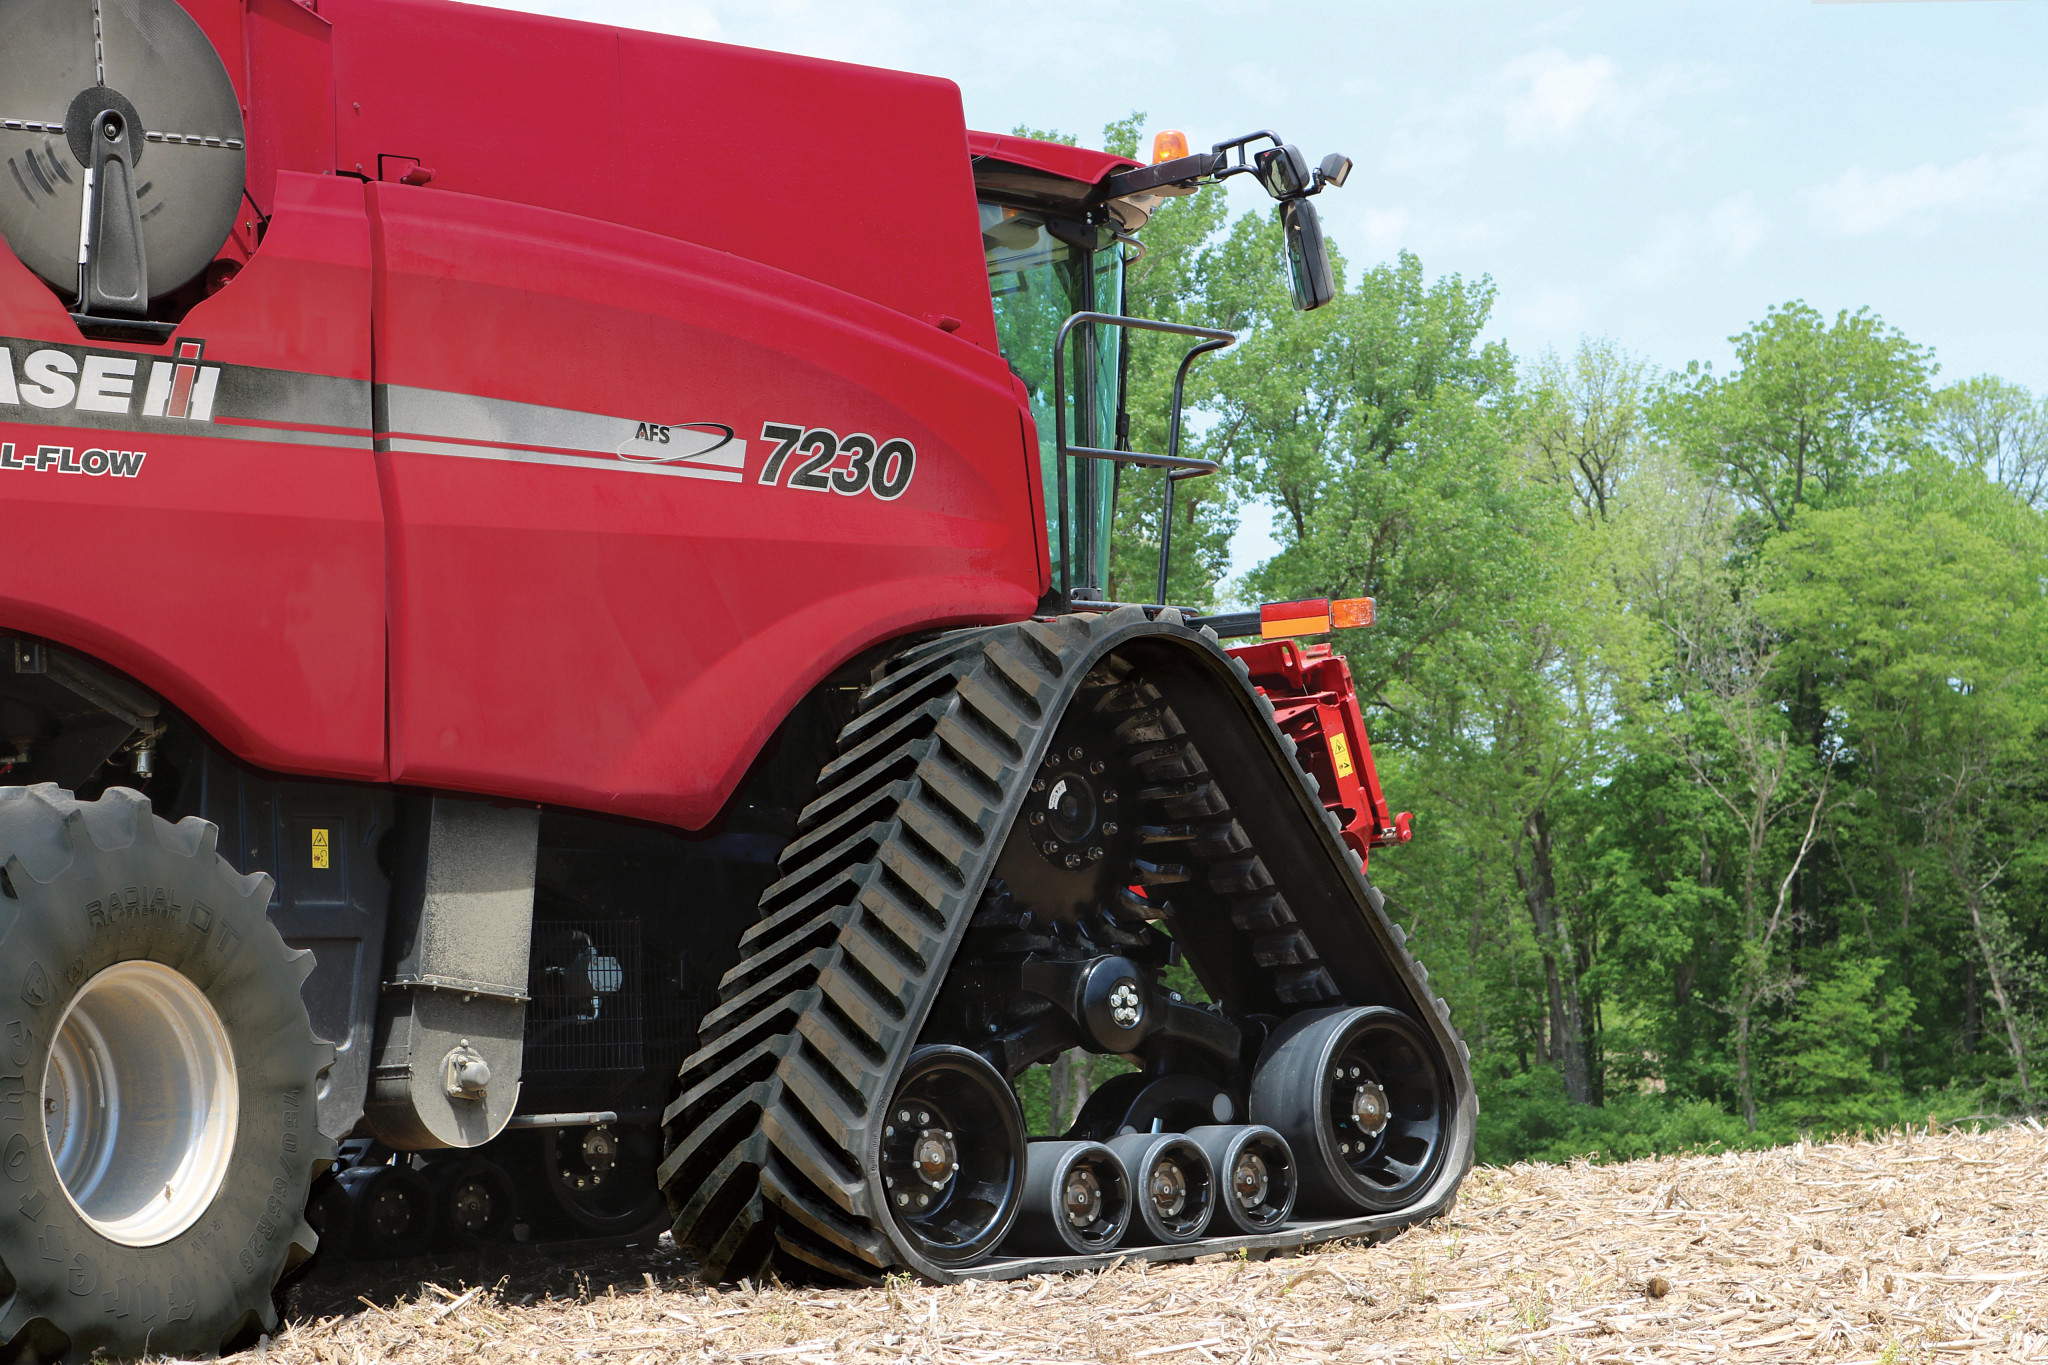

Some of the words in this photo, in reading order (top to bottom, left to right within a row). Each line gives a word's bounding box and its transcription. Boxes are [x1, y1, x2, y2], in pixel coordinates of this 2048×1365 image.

[0, 443, 146, 477] L-FLOW
[634, 422, 670, 444] AFS
[758, 421, 916, 500] 7230
[85, 886, 181, 928] RADIAL
[186, 899, 241, 950] DT
[239, 1089, 300, 1274] 750/65R26
